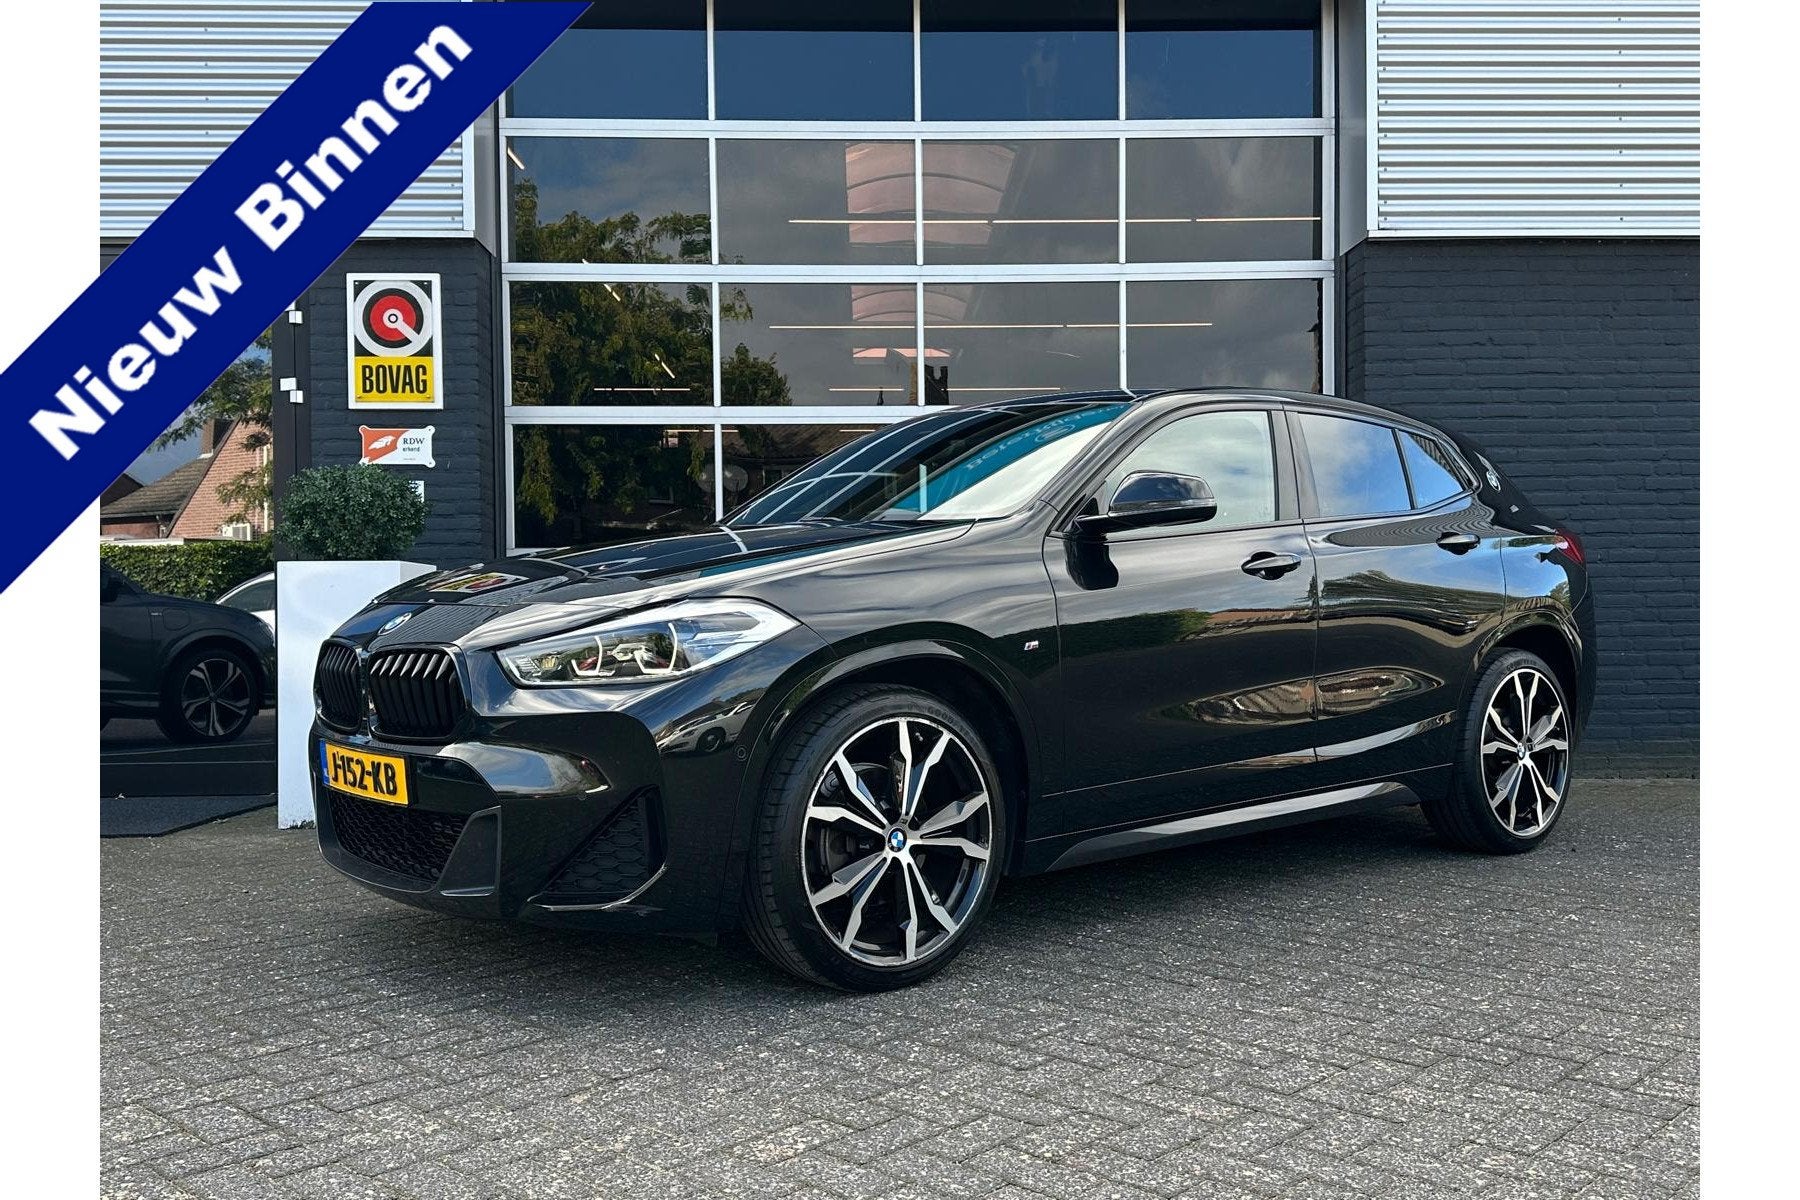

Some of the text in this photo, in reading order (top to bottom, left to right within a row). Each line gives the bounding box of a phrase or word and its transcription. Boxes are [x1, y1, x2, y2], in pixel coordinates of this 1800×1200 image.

[361, 364, 428, 394] BOVAG
[403, 437, 425, 445] RDW
[331, 751, 398, 796] J-152-KB
